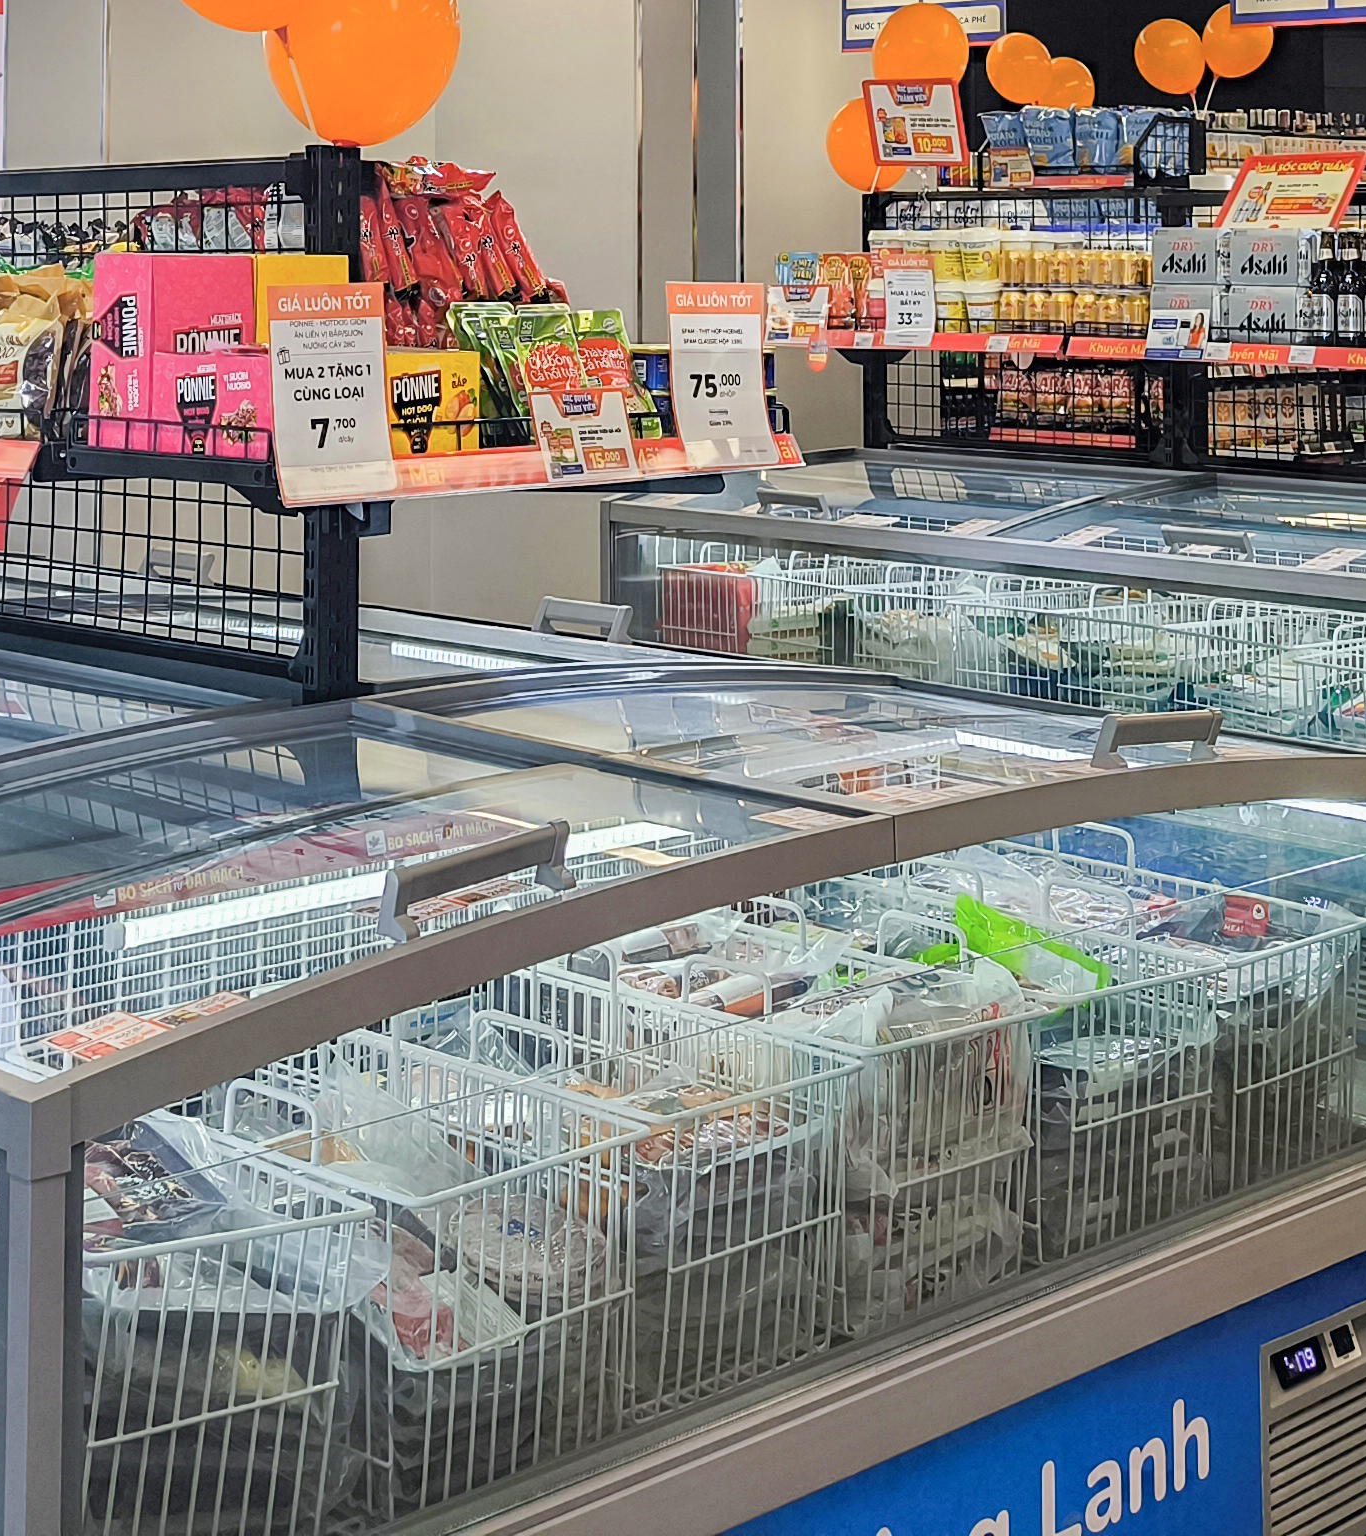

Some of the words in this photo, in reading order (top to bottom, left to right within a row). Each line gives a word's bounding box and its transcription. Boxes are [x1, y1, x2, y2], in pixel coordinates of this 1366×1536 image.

[854, 22, 875, 30] NƯỚC
[1171, 240, 1197, 253] DRY
[1251, 241, 1277, 253] DRY
[1161, 253, 1206, 274] Asahi
[1240, 254, 1288, 276] Asahi
[278, 293, 301, 312] GIÁ
[305, 292, 341, 311] LUÔN
[344, 290, 371, 310] TỐT
[676, 291, 694, 306] GIÁ
[697, 291, 727, 307] LUÔN
[731, 290, 753, 307] TỐT
[1169, 297, 1192, 309] DRY
[1249, 299, 1276, 310] DRY
[522, 321, 532, 330] SG
[1239, 313, 1286, 334] Asahi
[1258, 348, 1278, 361] Mãi
[285, 367, 314, 380] MUA
[318, 367, 324, 378] 2
[328, 363, 363, 380] TẶNG
[366, 364, 370, 375] 1
[294, 386, 330, 401] CÙNG
[335, 387, 364, 401] LOẠI
[402, 406, 415, 415] HOT
[417, 404, 432, 413] DOG
[589, 451, 620, 469] 15.000
